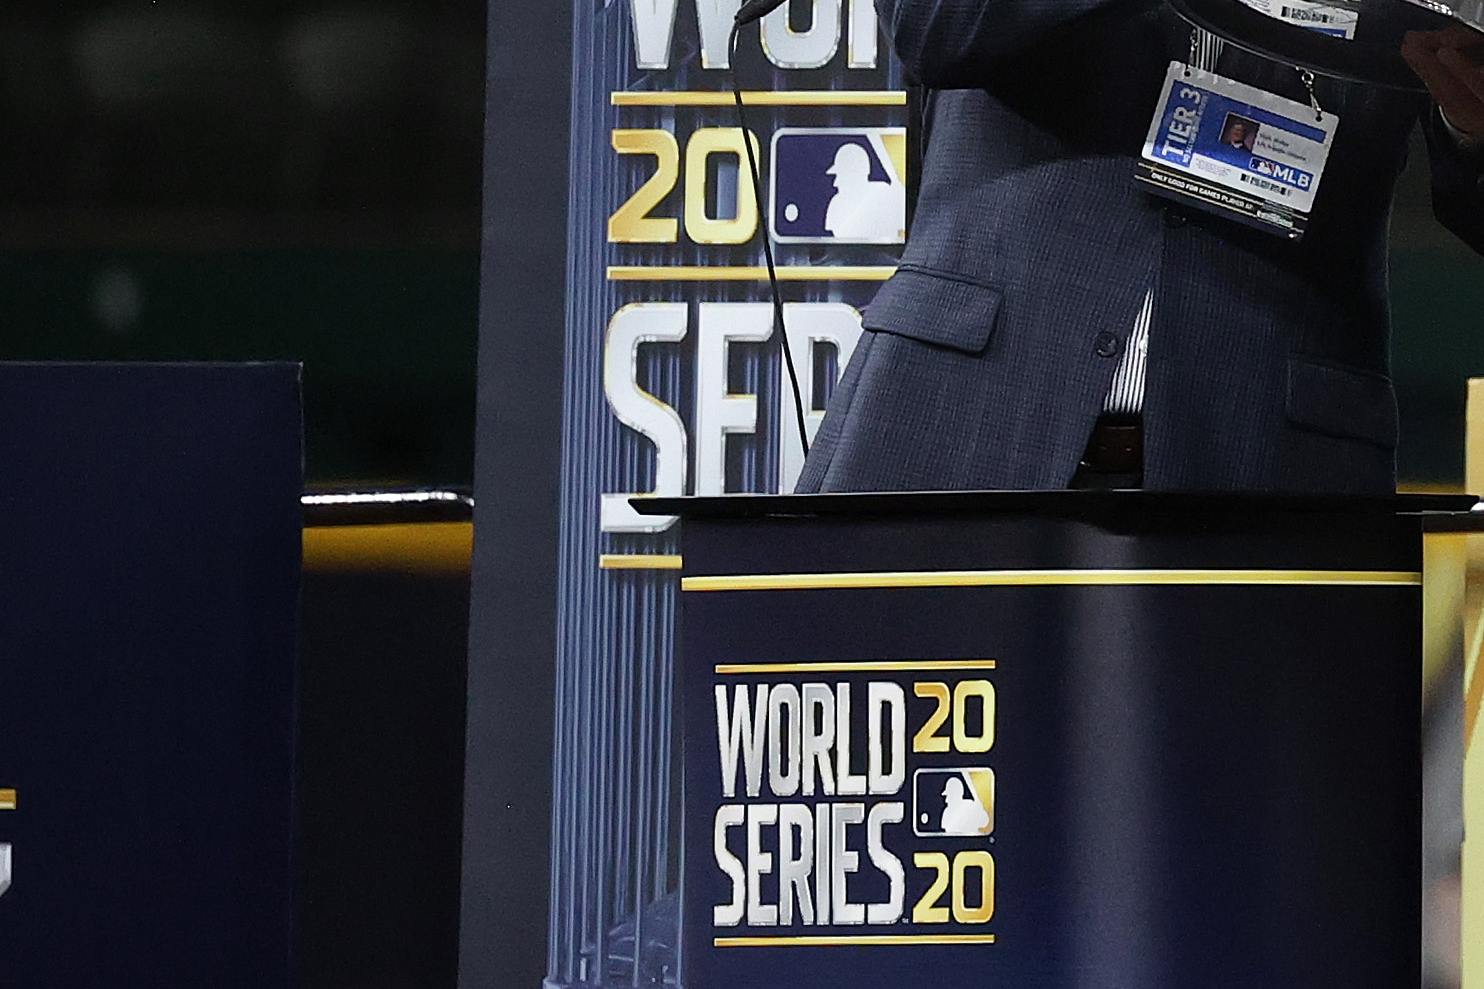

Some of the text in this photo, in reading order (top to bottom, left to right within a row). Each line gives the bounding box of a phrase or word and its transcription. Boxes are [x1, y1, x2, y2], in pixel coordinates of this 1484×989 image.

[1161, 106, 1197, 156] TIER
[1180, 87, 1201, 105] 3
[607, 127, 760, 244] 20
[1272, 164, 1311, 188] MLB
[714, 681, 907, 798] WORLD
[912, 679, 996, 753] 20
[713, 801, 906, 927] SERIES
[912, 850, 996, 924] 20
